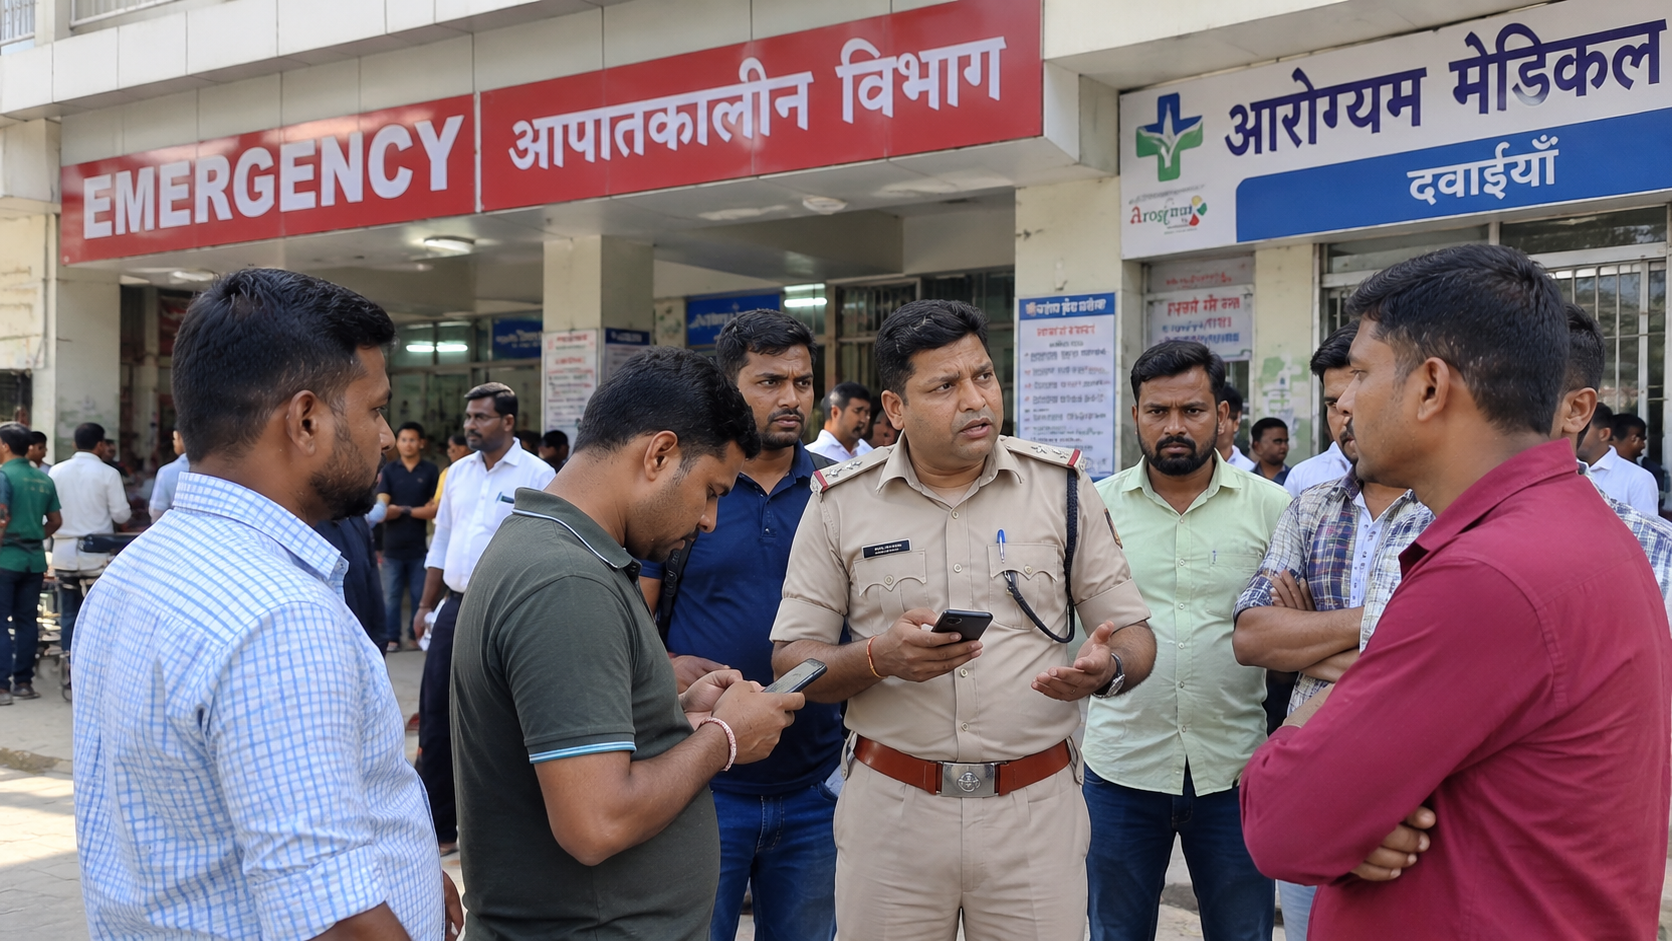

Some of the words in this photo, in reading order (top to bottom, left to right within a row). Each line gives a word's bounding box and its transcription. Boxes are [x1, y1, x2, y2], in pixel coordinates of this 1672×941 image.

[508, 57, 814, 170] आपातकालीन
[835, 36, 1007, 124] विभाग
[1225, 67, 1427, 157] आरोग्यम
[1448, 19, 1667, 114] मेडिकल
[82, 114, 465, 240] EMERGENCY
[1406, 134, 1560, 206] दवाईयाँ
